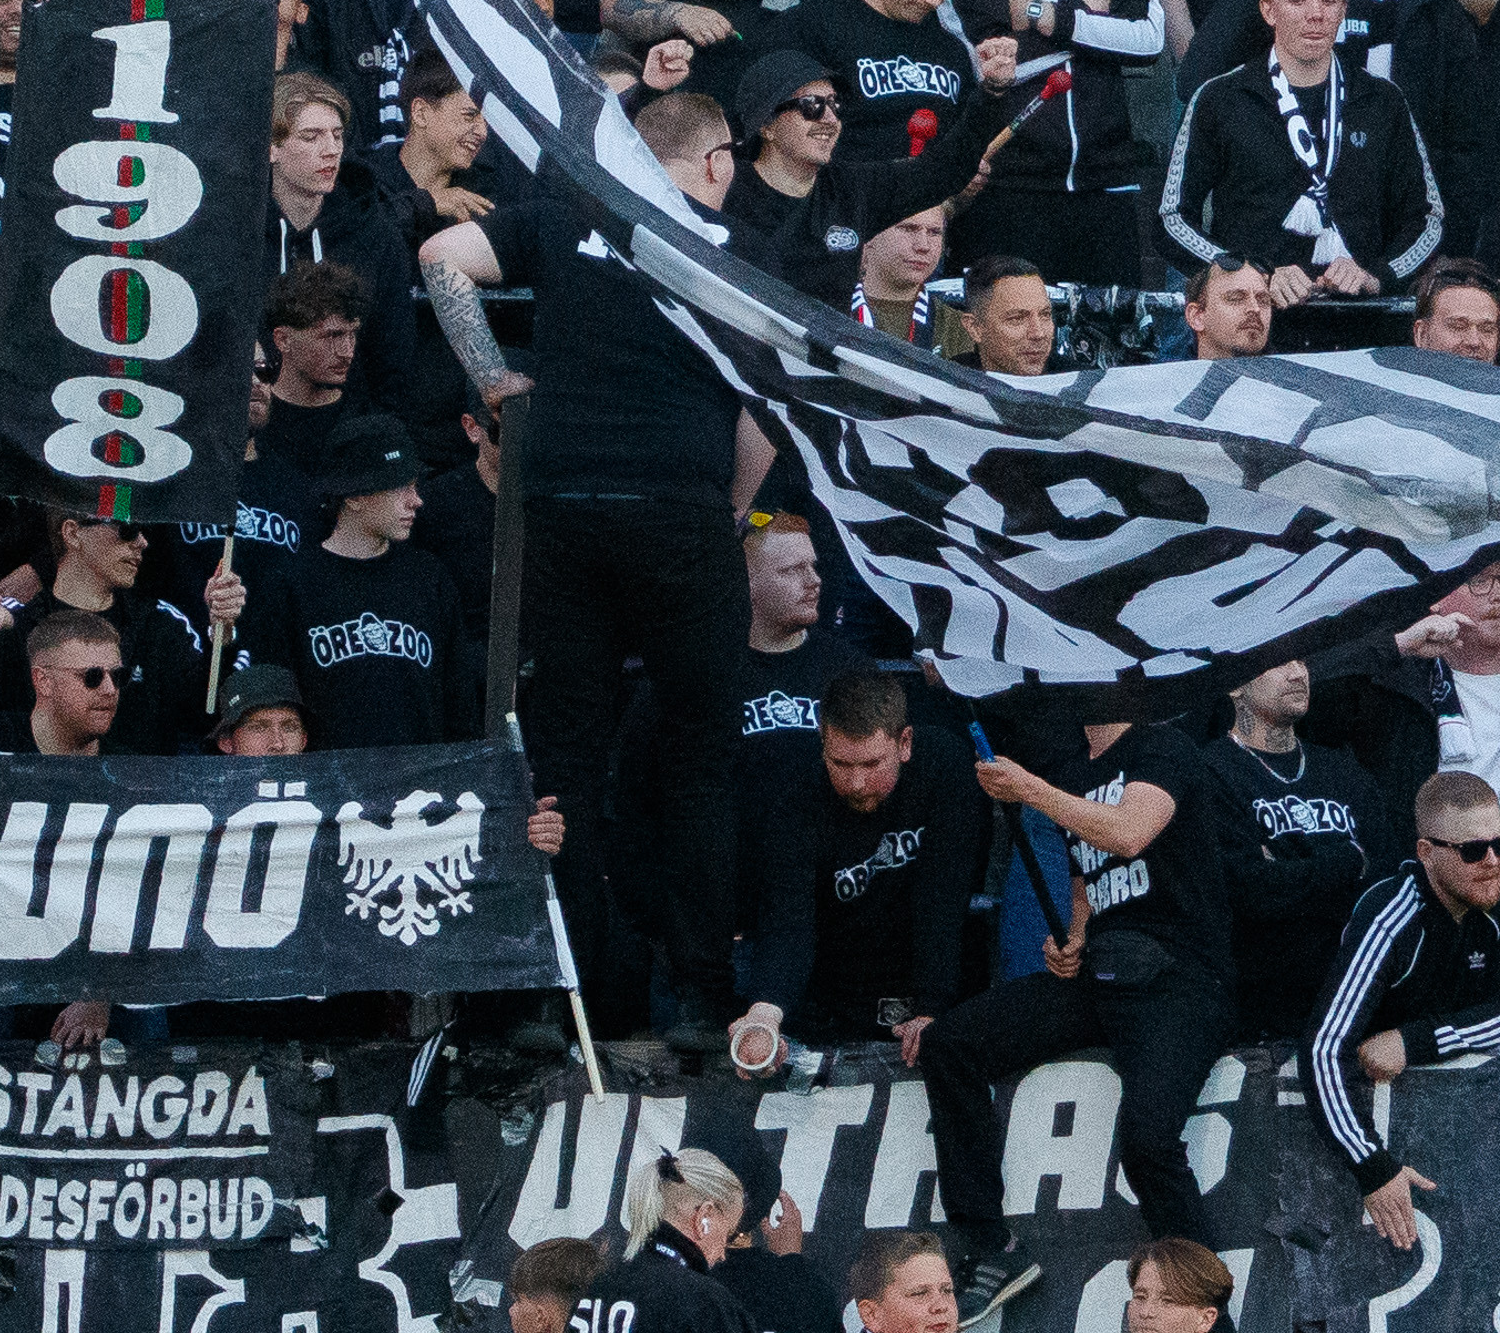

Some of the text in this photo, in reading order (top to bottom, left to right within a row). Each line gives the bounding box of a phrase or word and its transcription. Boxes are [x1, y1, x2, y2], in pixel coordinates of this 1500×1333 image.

[44, 19, 204, 483] 1908
[310, 619, 434, 668] ÖRE ZOO
